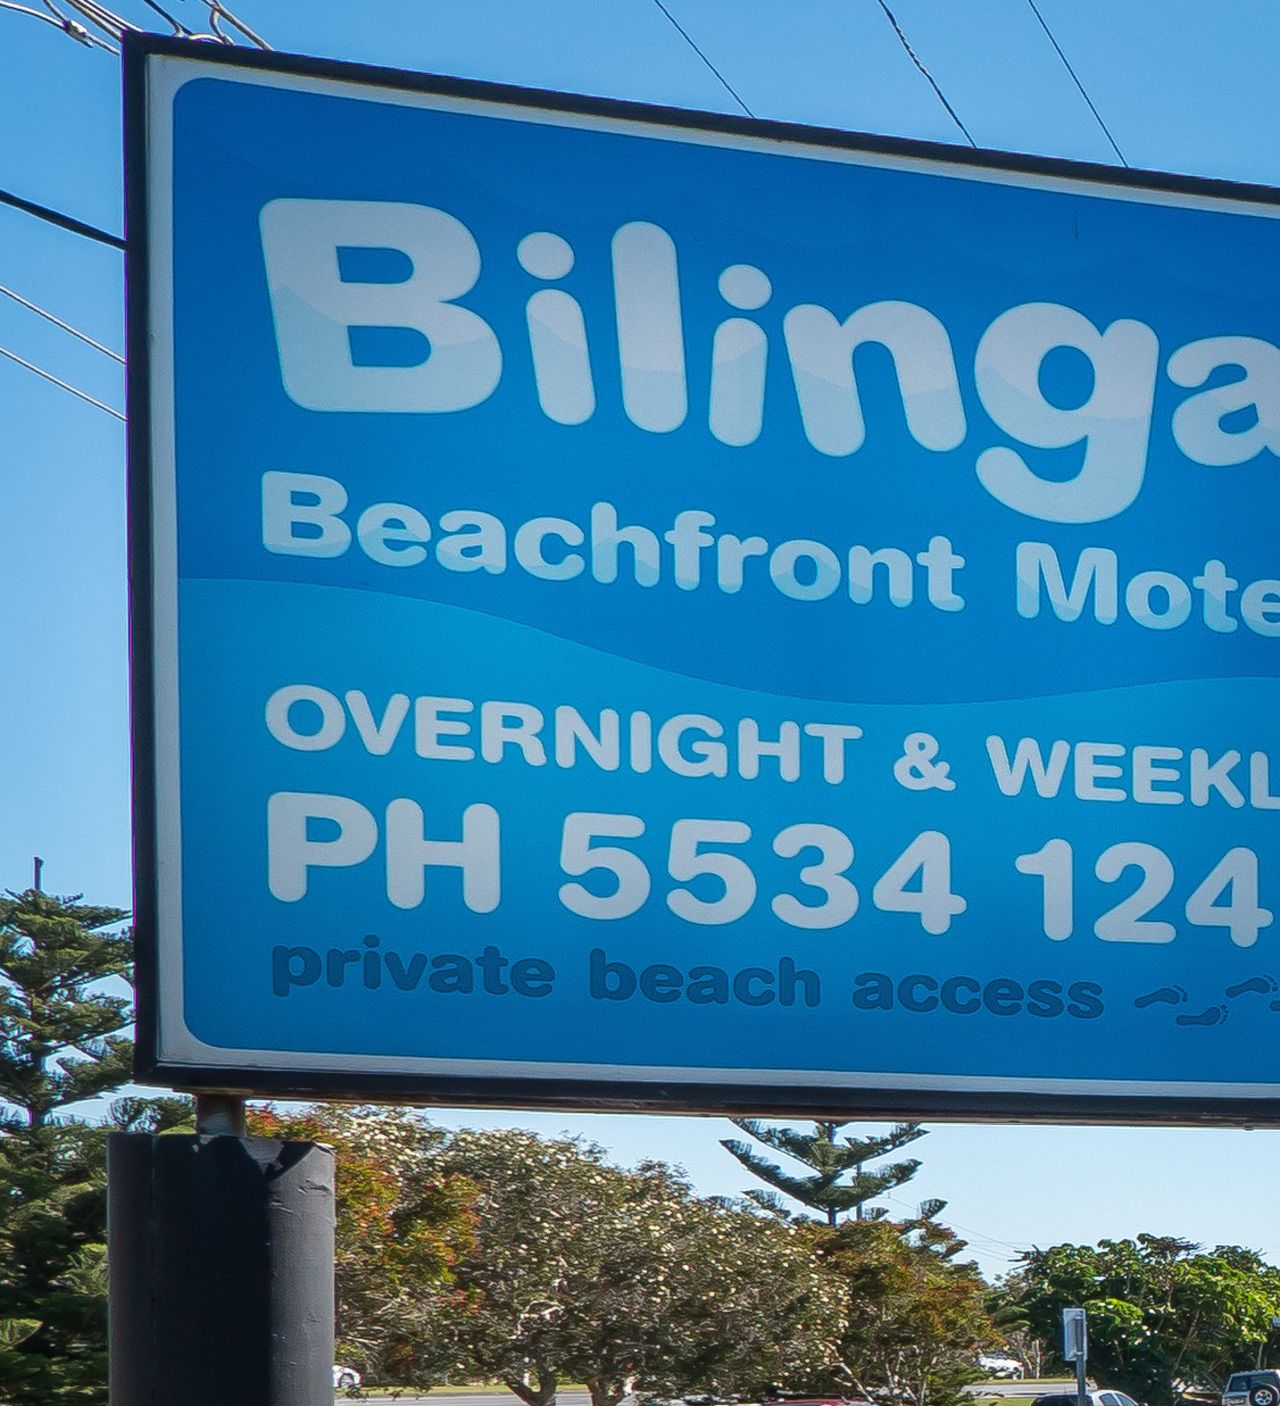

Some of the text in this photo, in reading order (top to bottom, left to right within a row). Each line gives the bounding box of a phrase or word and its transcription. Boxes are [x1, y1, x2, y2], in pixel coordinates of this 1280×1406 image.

[261, 470, 966, 612] Beachfront
[264, 684, 863, 785] OVERNIGHT
[893, 731, 957, 792] &
[266, 791, 503, 914] PH
[558, 811, 967, 936] 5534
[271, 934, 1105, 1020] private beach access
